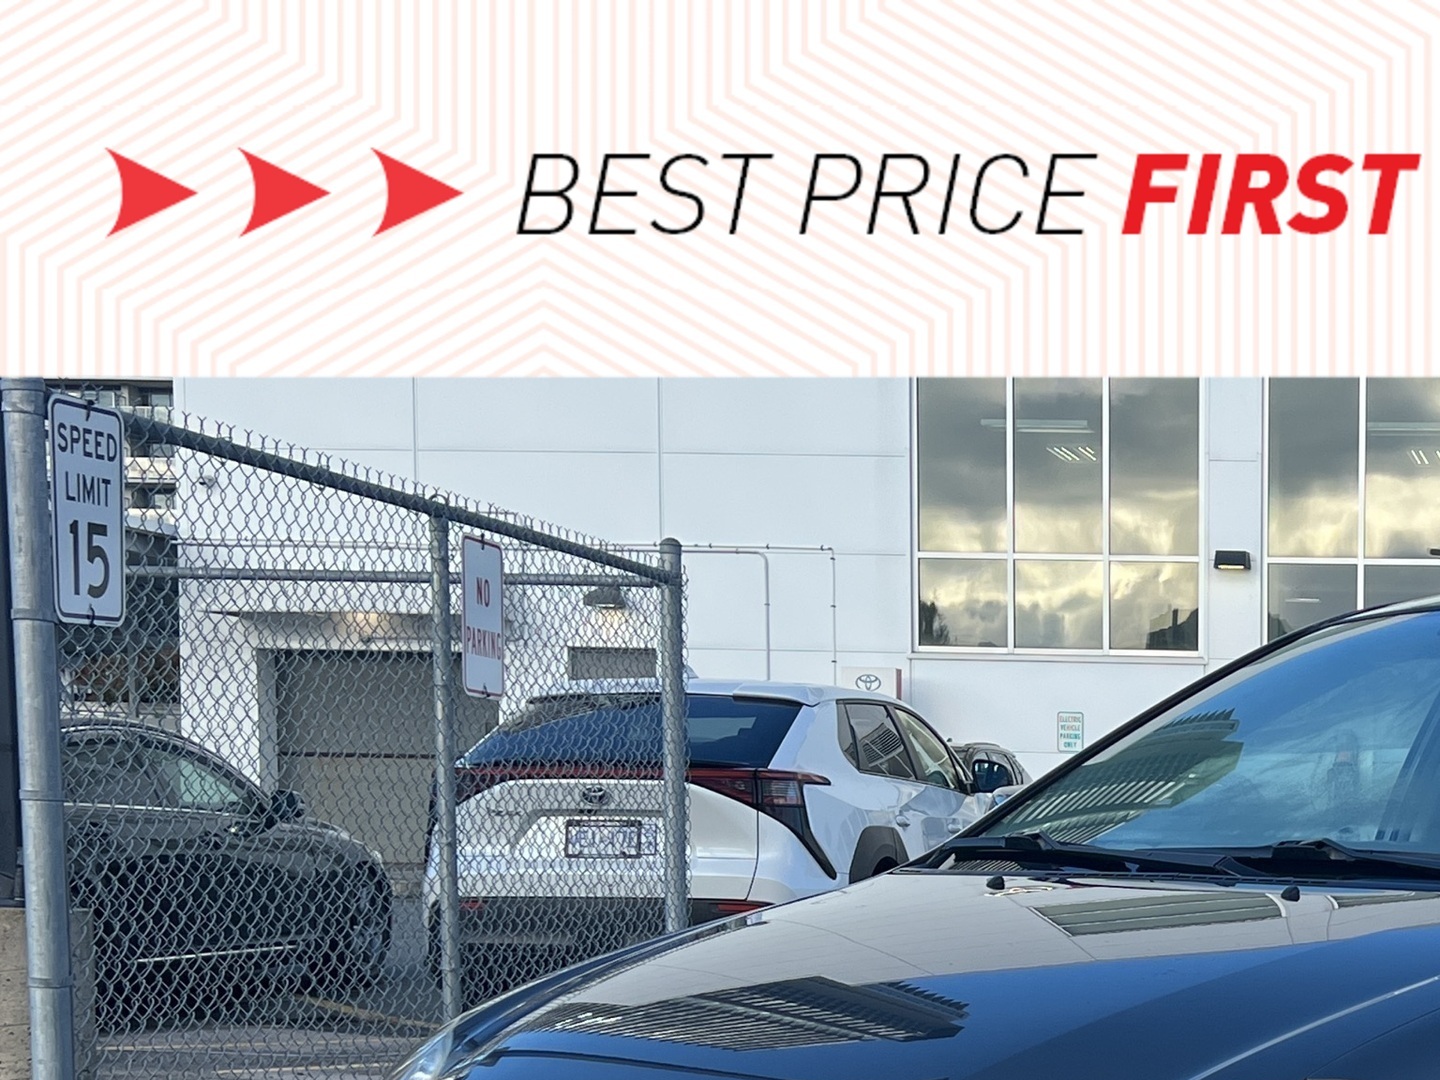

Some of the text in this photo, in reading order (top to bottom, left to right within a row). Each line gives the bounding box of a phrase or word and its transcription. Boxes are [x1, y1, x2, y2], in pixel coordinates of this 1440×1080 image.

[57, 422, 118, 463] SPEED
[65, 471, 111, 508] LIMIT
[69, 519, 110, 599] 15
[476, 576, 491, 608] NO
[466, 625, 502, 661] PARKING
